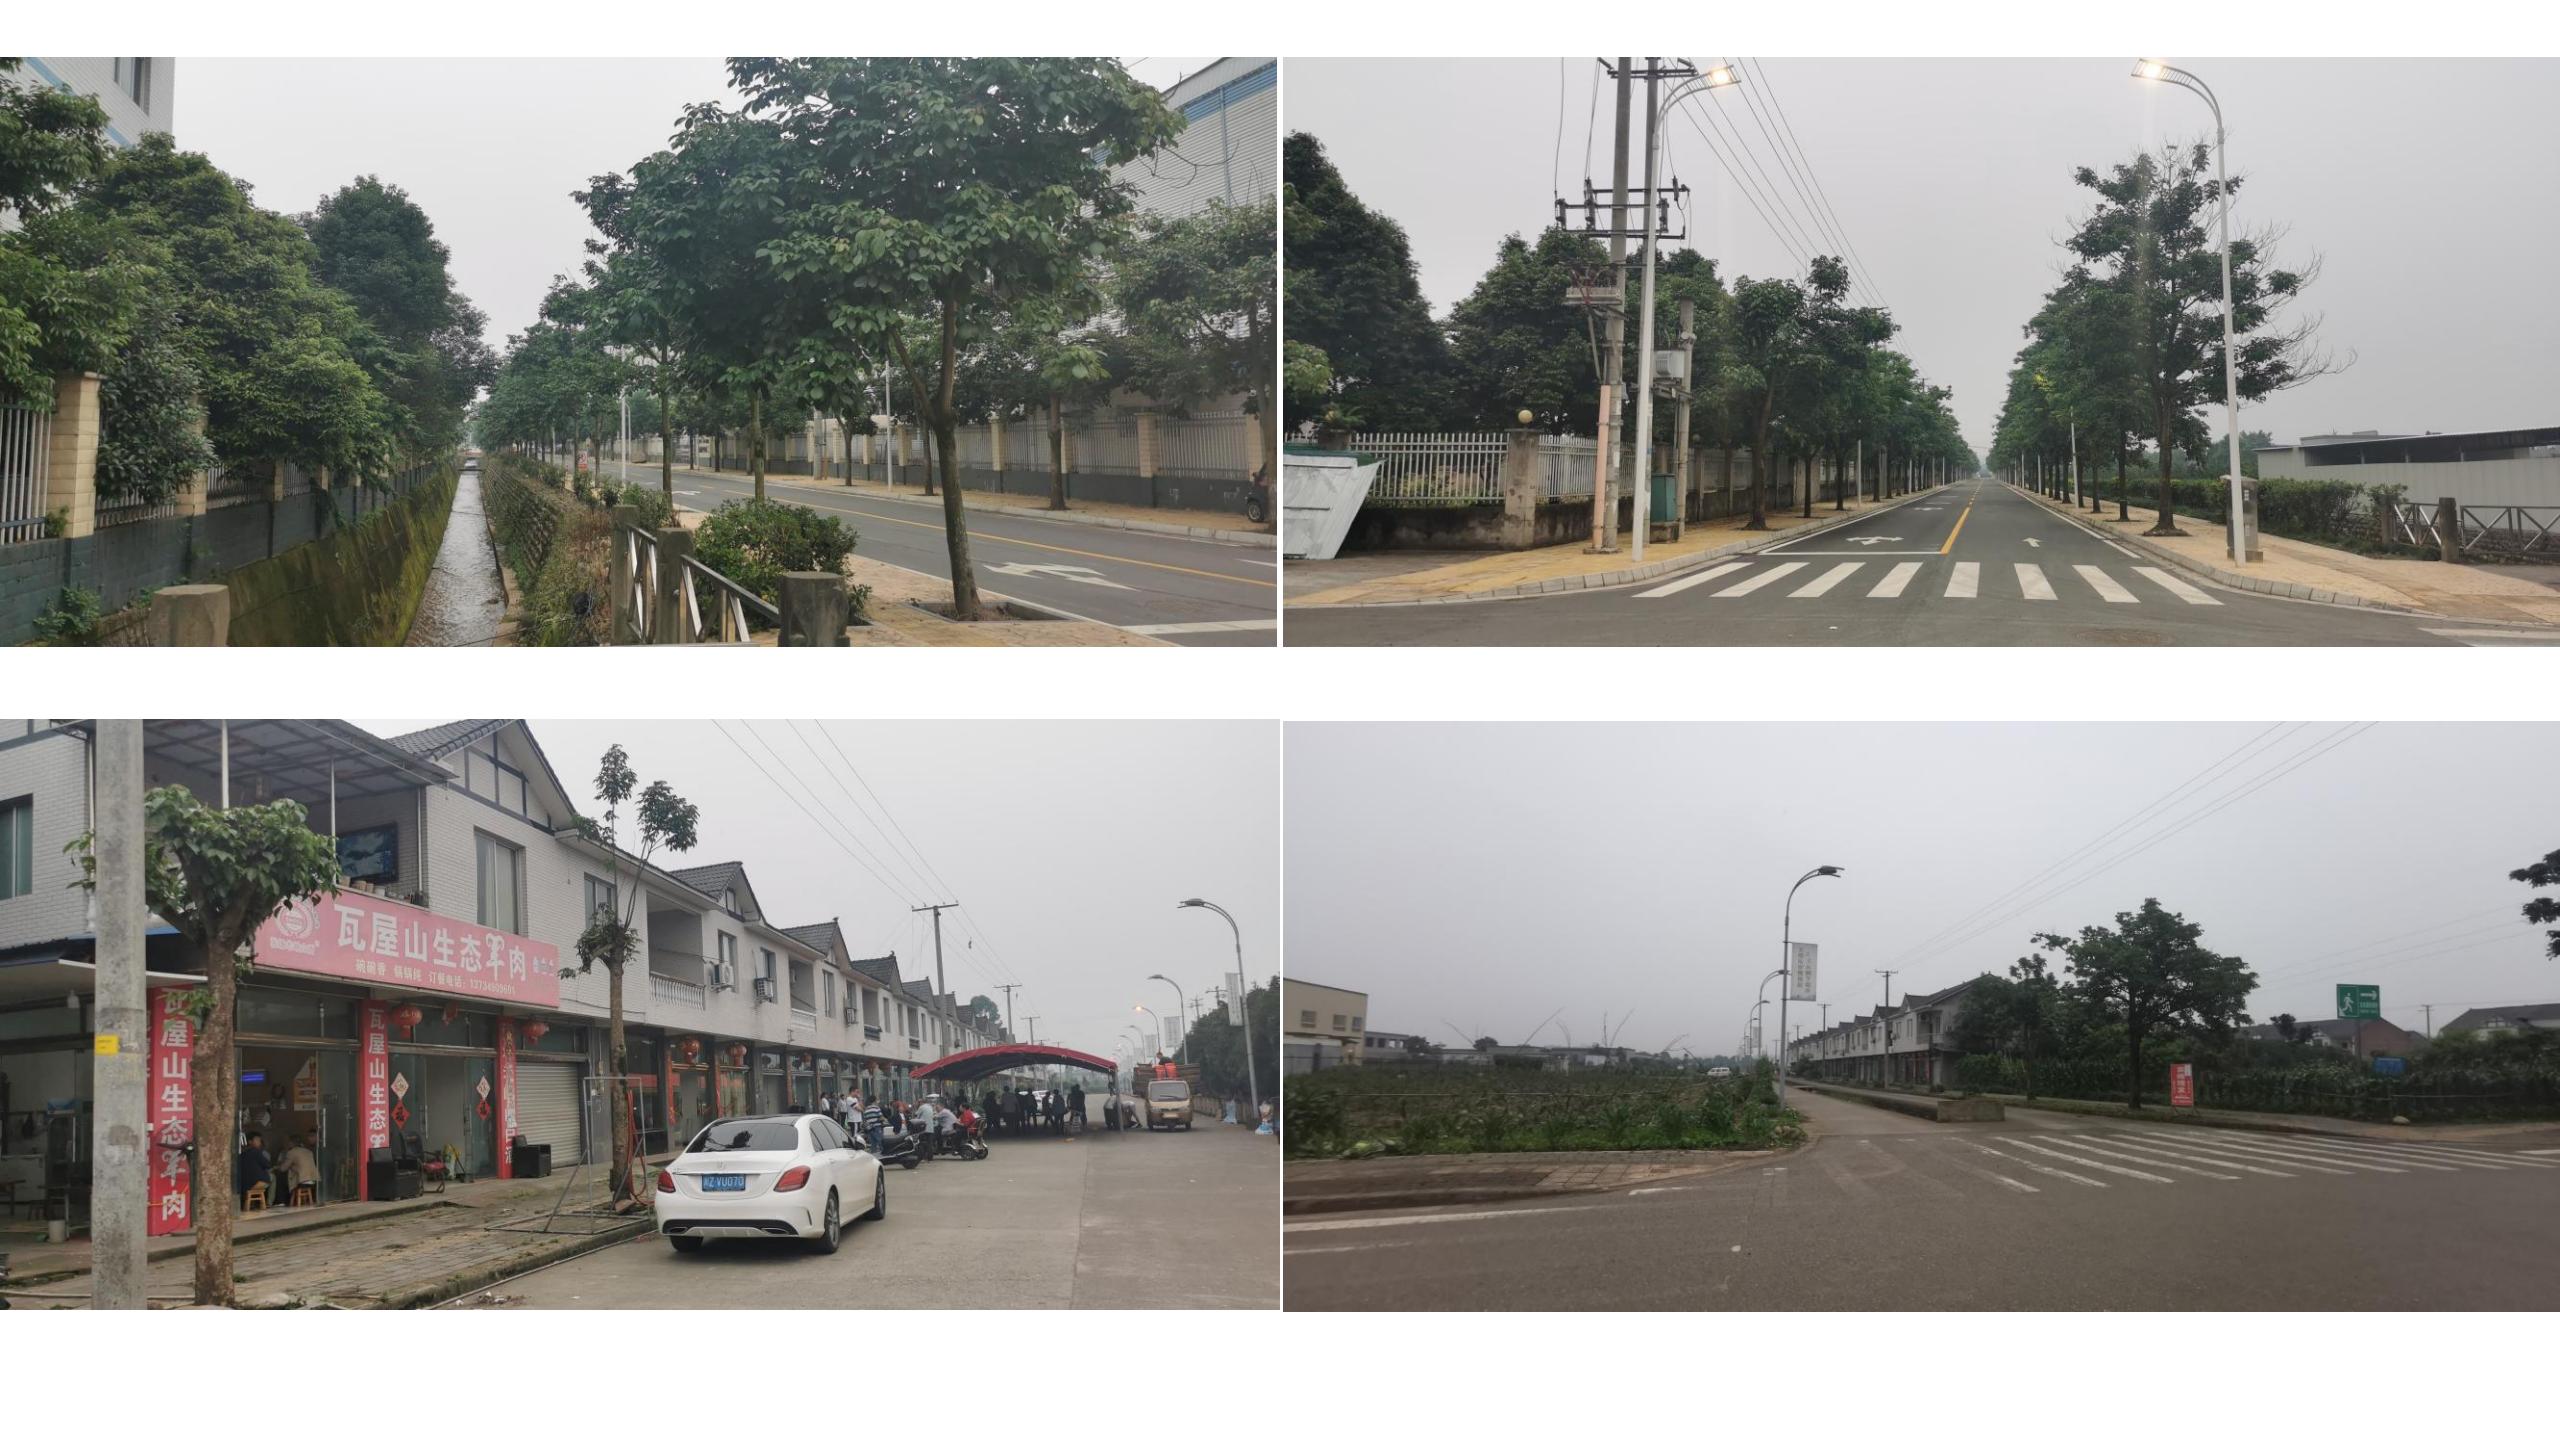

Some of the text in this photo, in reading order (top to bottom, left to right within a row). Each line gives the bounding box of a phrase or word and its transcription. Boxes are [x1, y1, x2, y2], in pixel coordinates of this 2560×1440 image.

[334, 903, 527, 982] 瓦屋山生态羊肉
